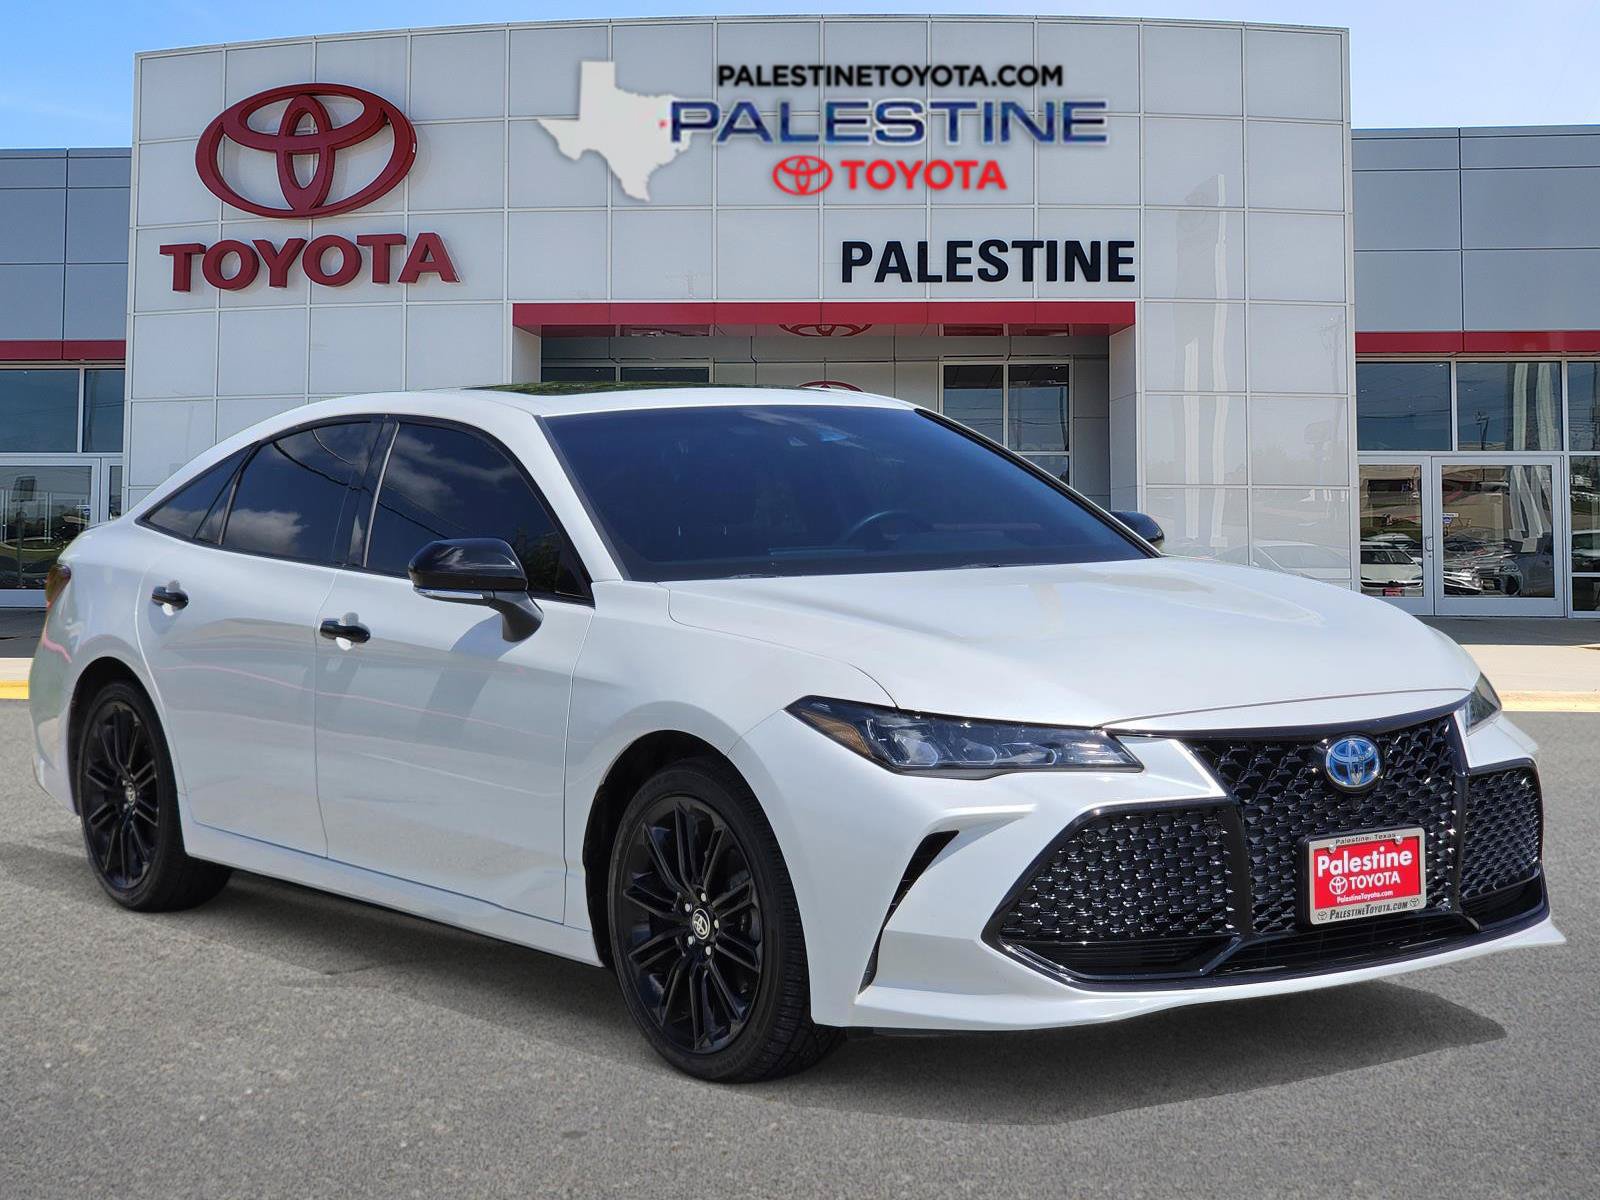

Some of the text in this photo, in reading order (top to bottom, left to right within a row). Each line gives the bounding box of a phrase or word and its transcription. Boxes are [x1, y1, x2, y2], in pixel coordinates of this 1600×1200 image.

[159, 232, 460, 292] TOYOTA
[842, 240, 1135, 283] PALESTINE
[1318, 846, 1412, 877] Palestine
[1349, 871, 1400, 889] TOYOTA
